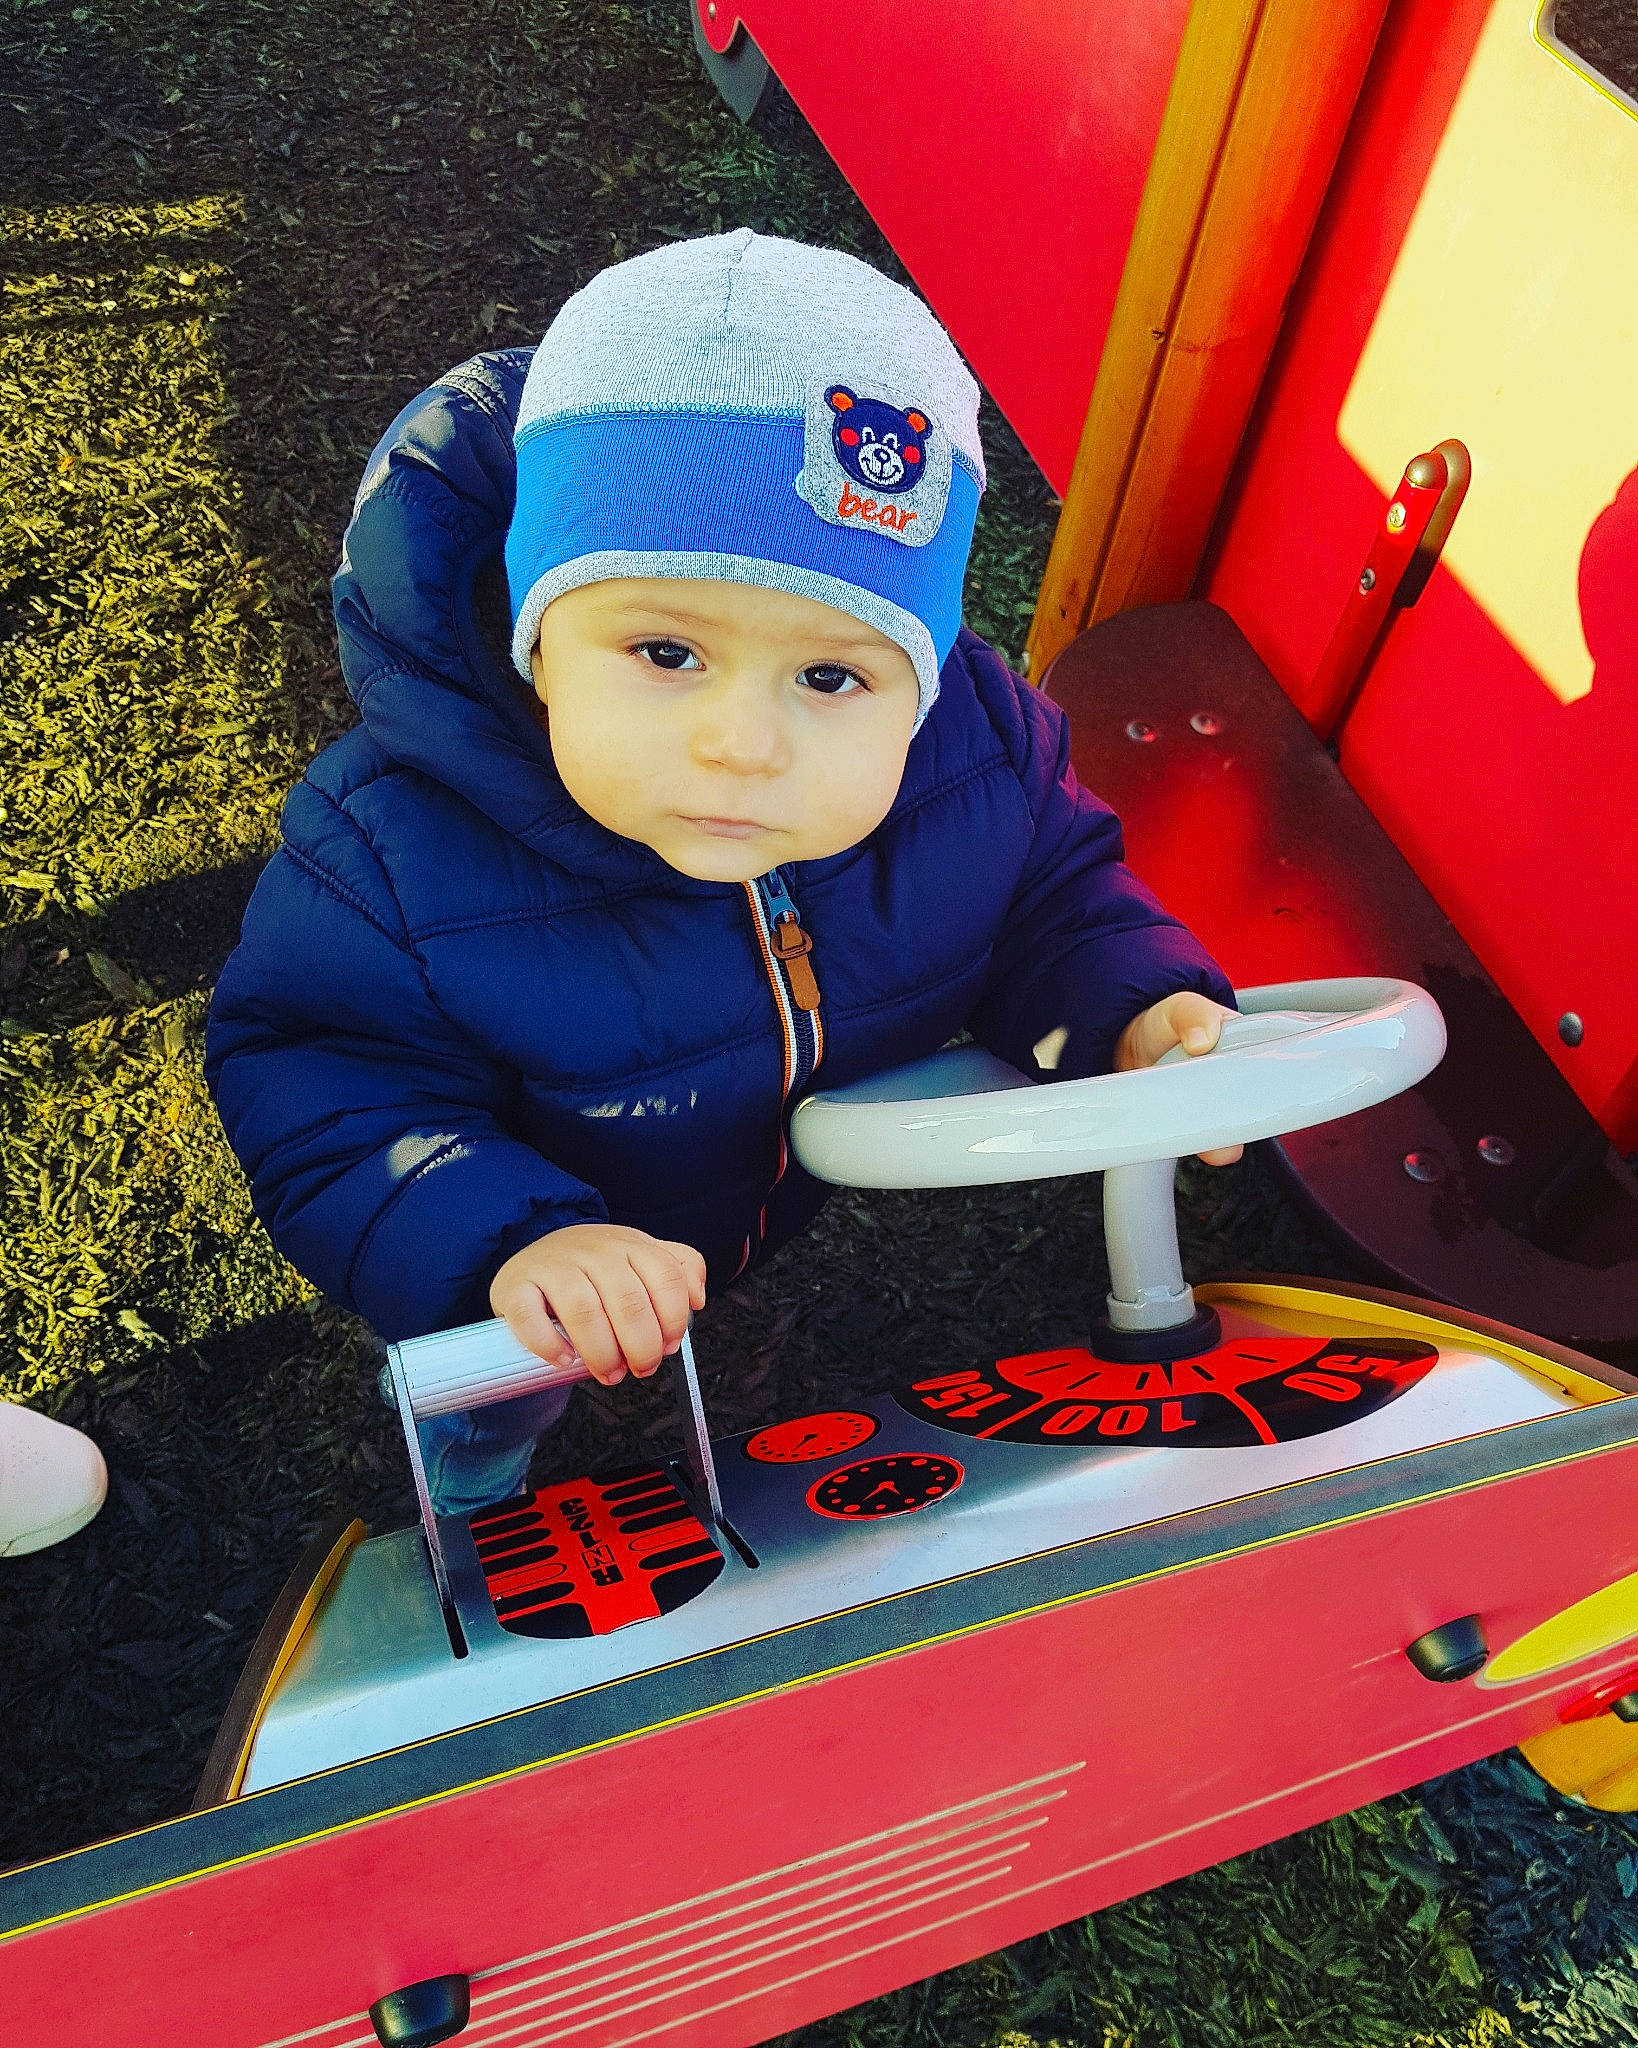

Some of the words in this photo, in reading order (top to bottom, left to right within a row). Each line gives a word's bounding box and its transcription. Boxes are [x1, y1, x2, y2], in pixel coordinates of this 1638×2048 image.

[837, 481, 917, 530] bear
[911, 1370, 1011, 1418] 150
[1282, 1355, 1400, 1402] 50
[1040, 1401, 1196, 1436] 100
